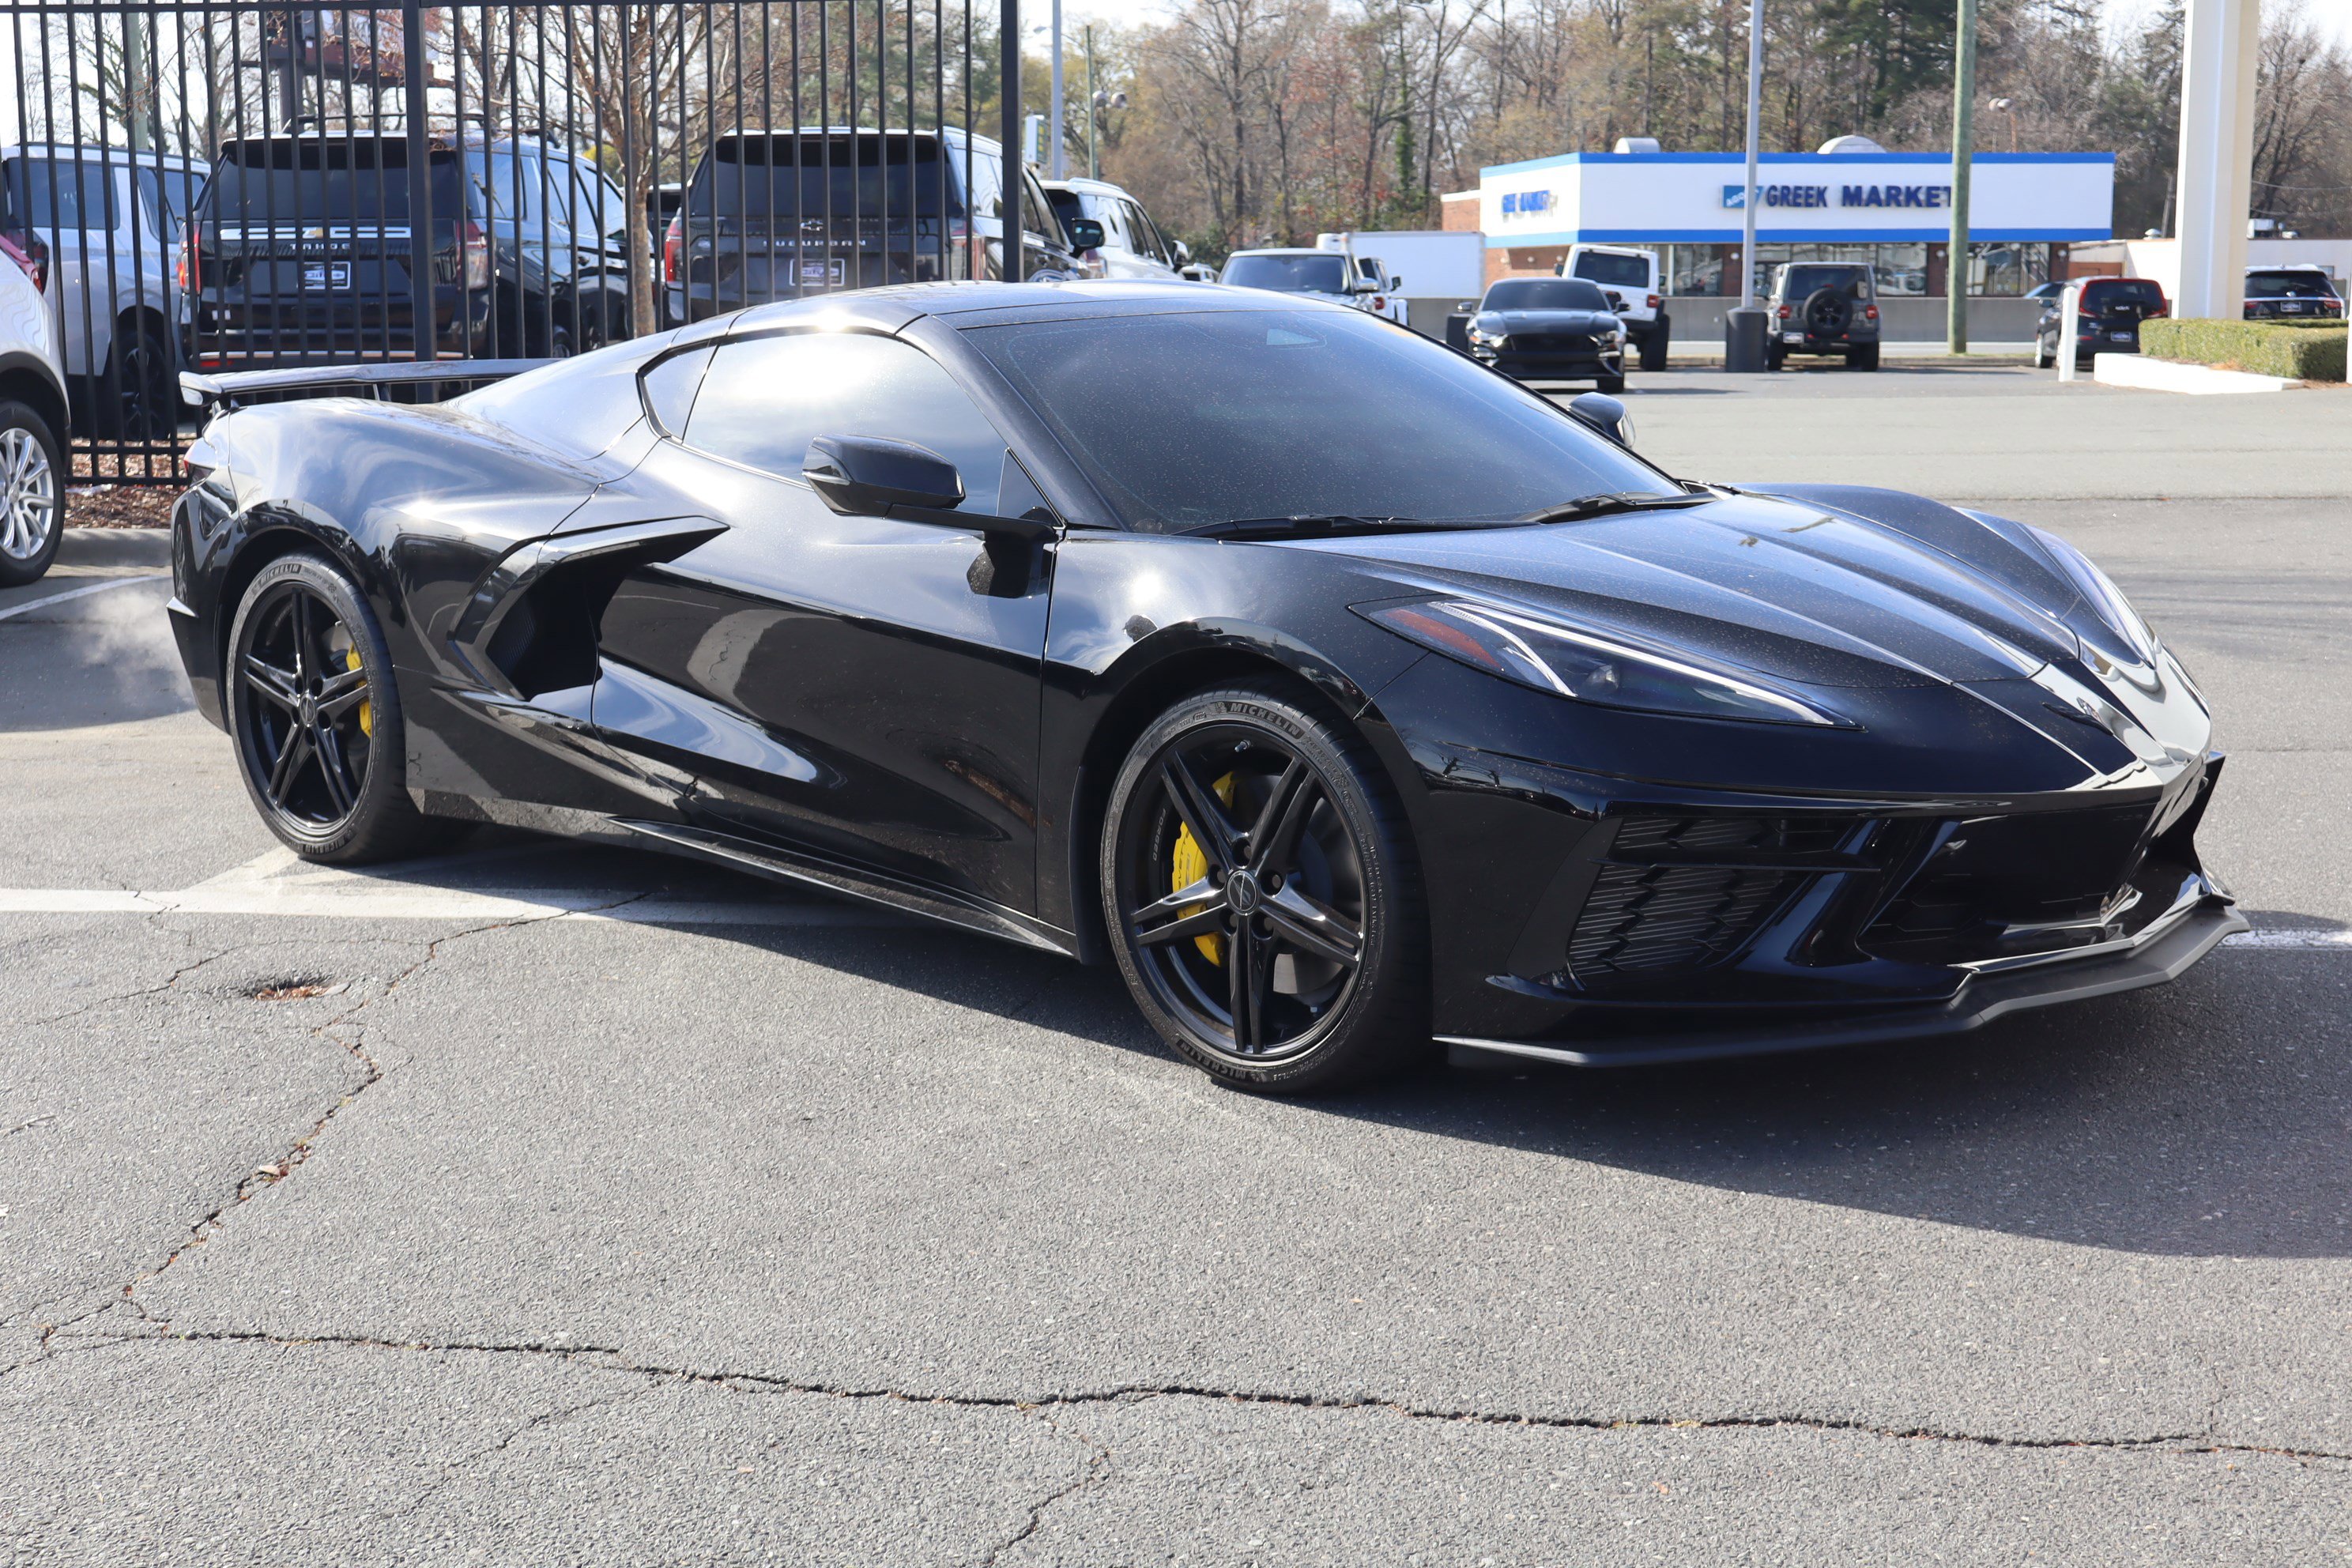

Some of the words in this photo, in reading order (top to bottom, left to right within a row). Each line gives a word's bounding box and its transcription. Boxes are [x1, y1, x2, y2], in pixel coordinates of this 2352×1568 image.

[1766, 185, 1828, 208] GREEK
[260, 564, 300, 584] MICHELIN
[1230, 702, 1303, 737] MICHELIN
[1152, 808, 1167, 861] FORGED
[1181, 1041, 1247, 1080] MICHELIN
